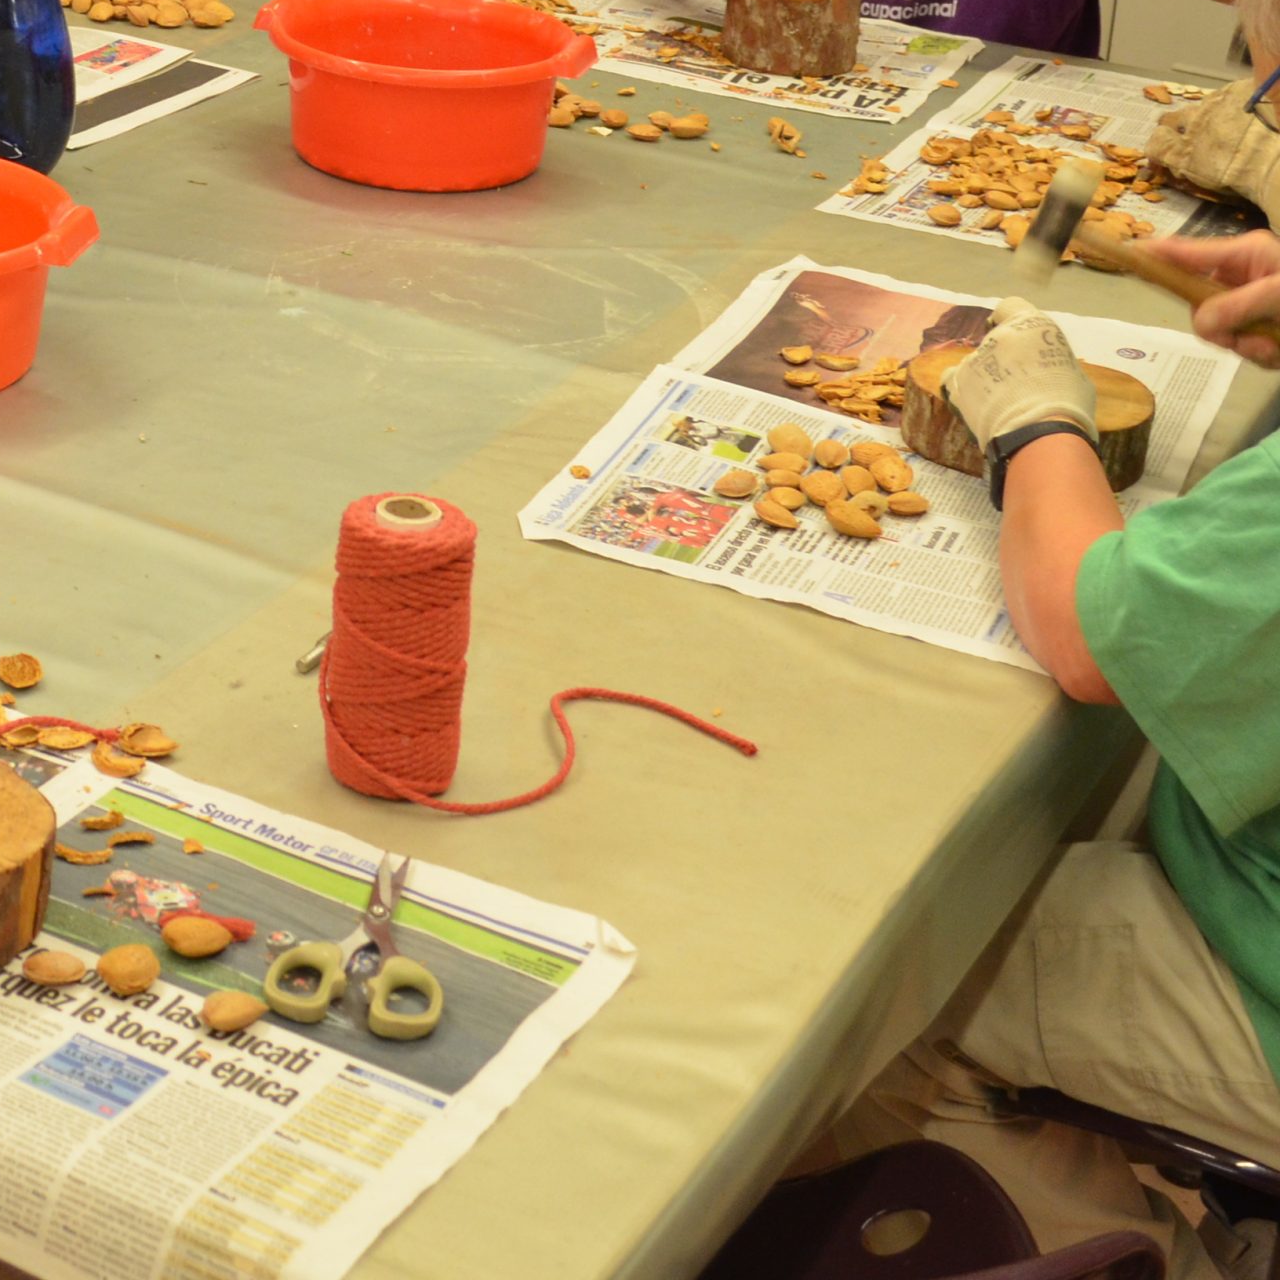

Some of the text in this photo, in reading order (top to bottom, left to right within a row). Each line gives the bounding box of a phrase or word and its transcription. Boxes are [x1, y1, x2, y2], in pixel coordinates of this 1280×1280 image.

[858, 0, 959, 21] cupacional
[199, 801, 254, 832] Sport
[254, 823, 315, 854] Motor
[157, 995, 202, 1031] las
[69, 996, 106, 1025] le
[104, 1011, 179, 1056] toca
[210, 1055, 300, 1108] épica
